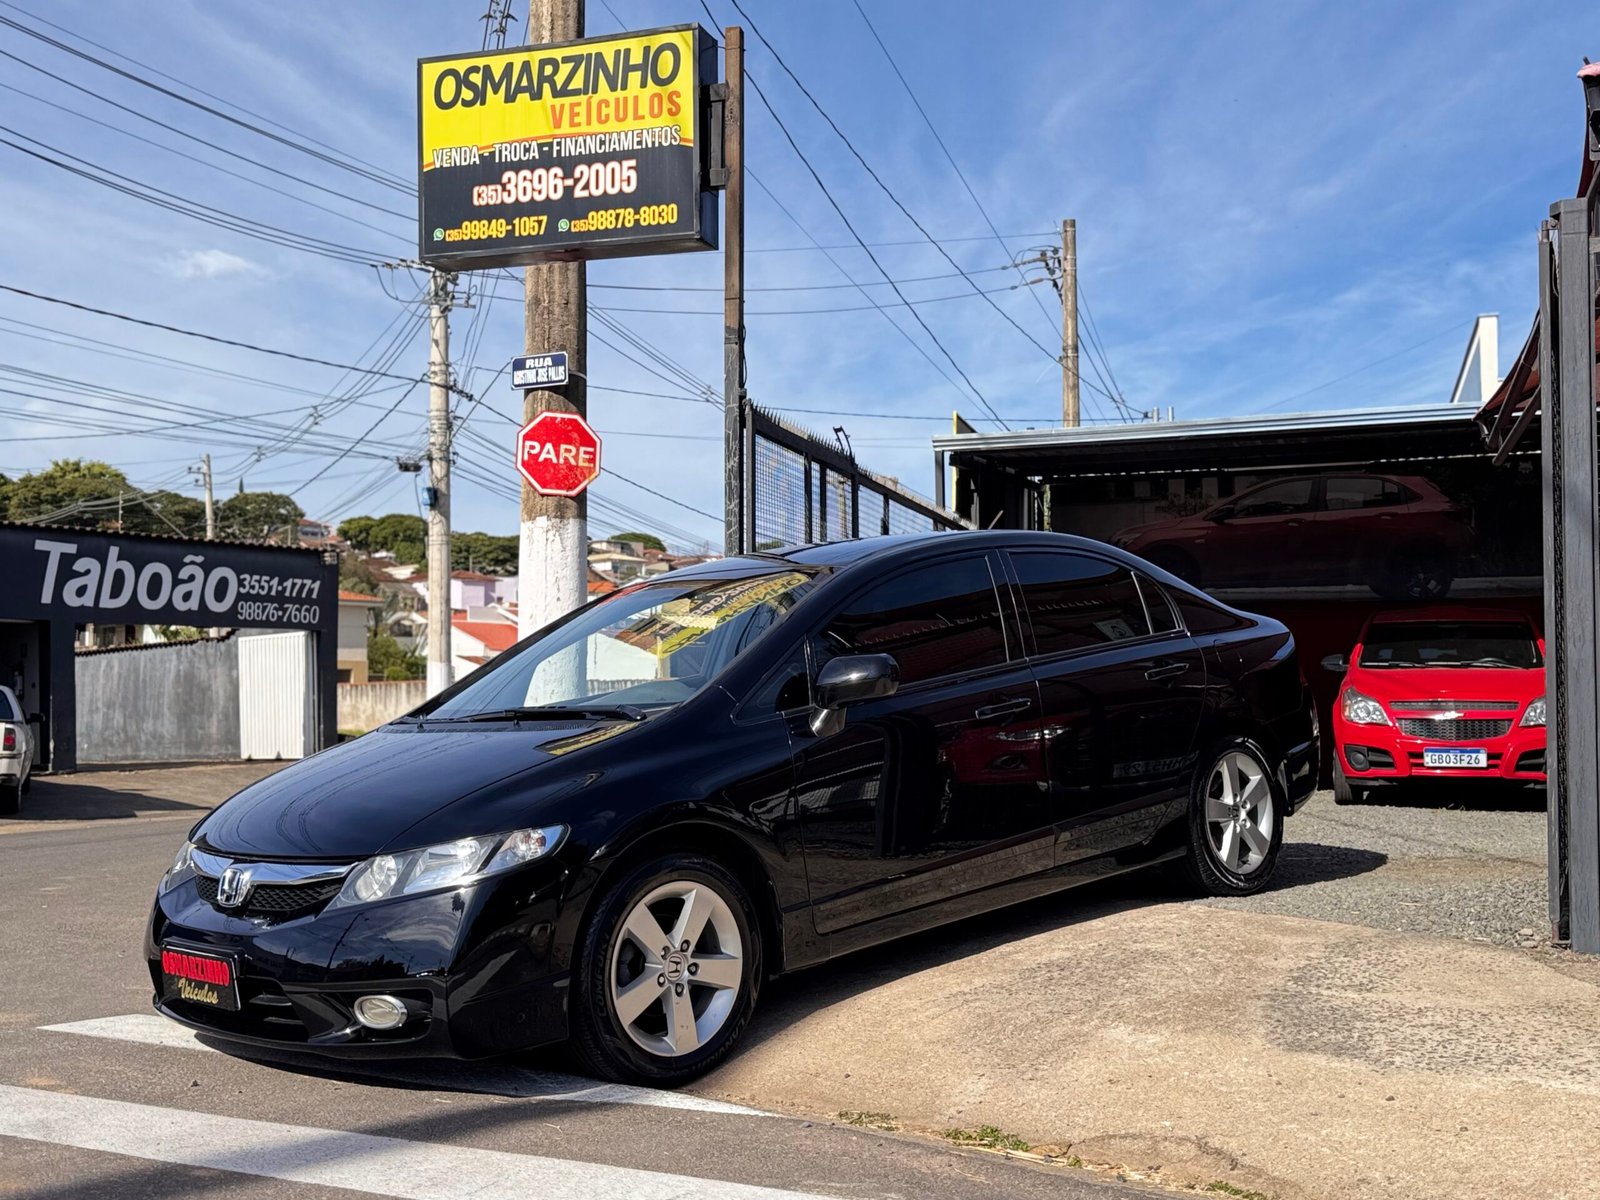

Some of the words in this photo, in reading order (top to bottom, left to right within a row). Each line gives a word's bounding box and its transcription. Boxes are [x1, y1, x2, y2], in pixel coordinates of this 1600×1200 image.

[433, 42, 681, 111] OSMARZINHO
[550, 90, 682, 129] VEÍCULOS
[433, 146, 480, 168] VENDA
[493, 140, 539, 163] TROCA
[552, 125, 681, 158] FINANCIAMENTOS
[525, 357, 552, 368] RUA
[523, 440, 595, 468] PARE
[34, 539, 238, 612] Taboão
[162, 951, 229, 986] OSMARZINHO
